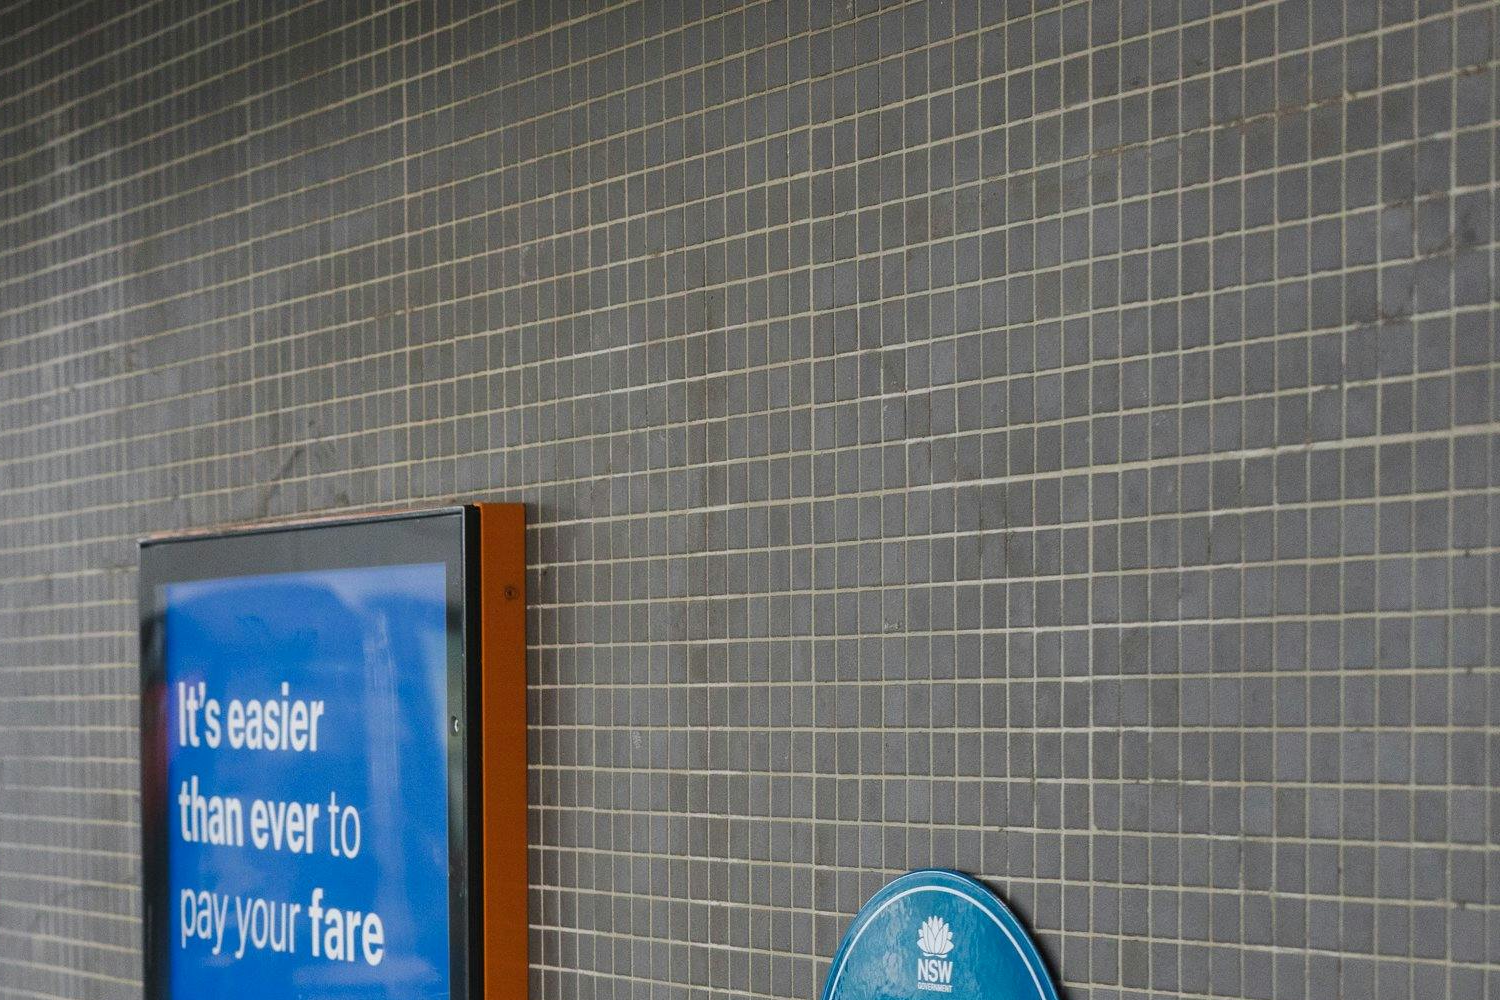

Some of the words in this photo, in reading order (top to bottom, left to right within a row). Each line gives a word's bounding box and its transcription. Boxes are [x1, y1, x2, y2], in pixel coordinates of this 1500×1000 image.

[178, 682, 221, 748] It's
[228, 682, 324, 752] easier
[178, 776, 243, 847] than
[251, 798, 320, 854] ever
[328, 792, 361, 859] to
[180, 888, 228, 955] pay
[235, 894, 301, 960] your
[309, 887, 385, 966] fare
[917, 958, 953, 983] NSW
[917, 983, 953, 993] GOVERNMENT
